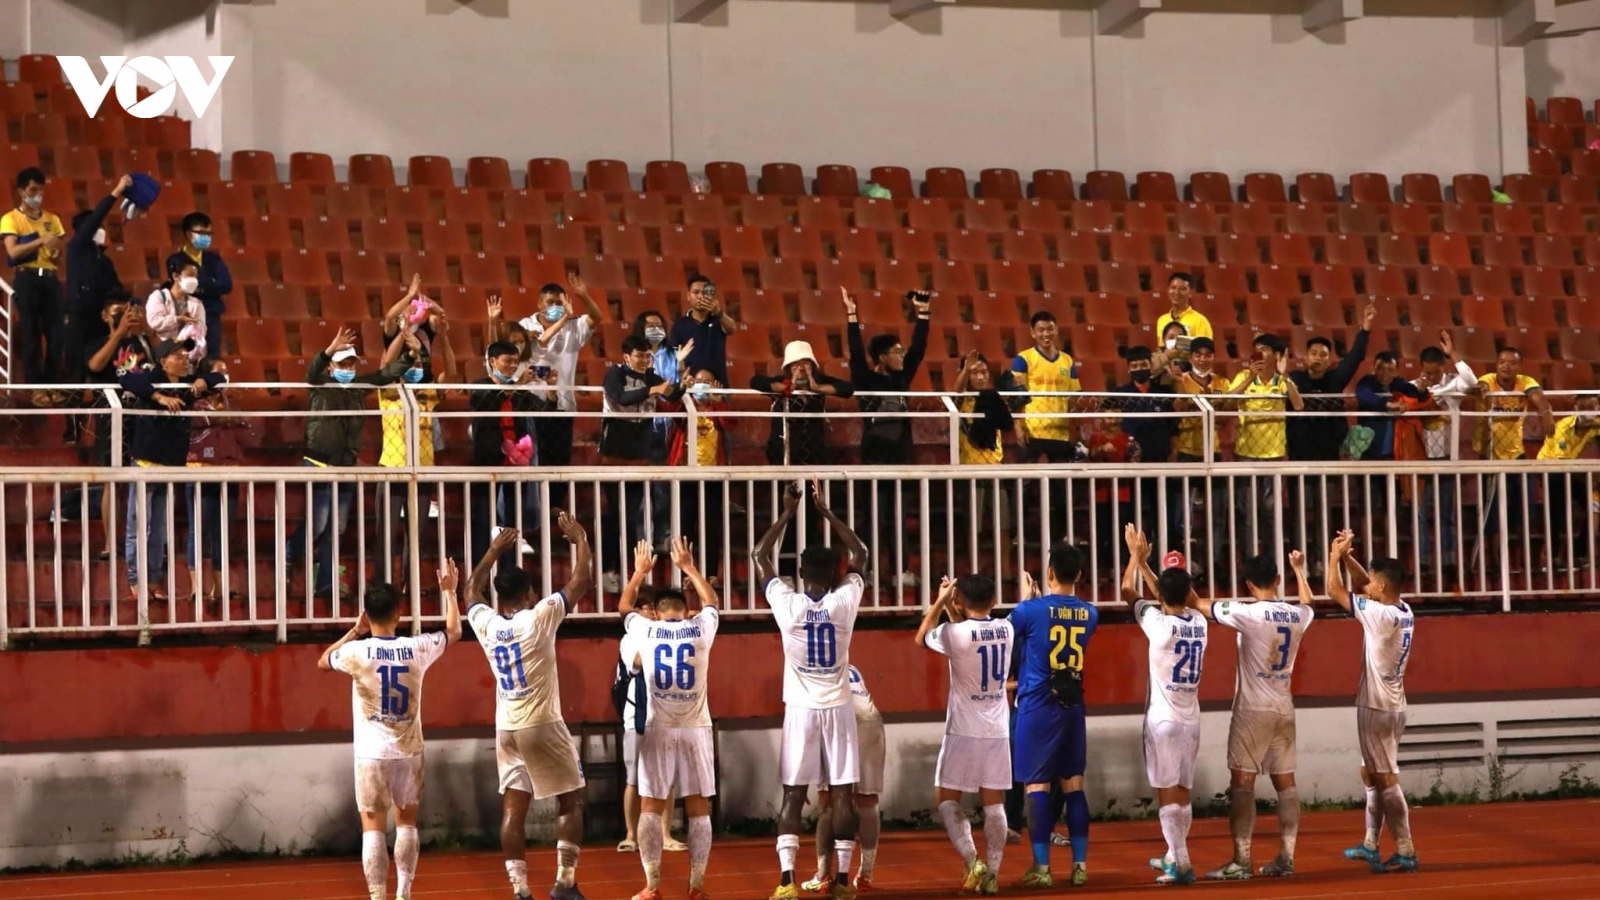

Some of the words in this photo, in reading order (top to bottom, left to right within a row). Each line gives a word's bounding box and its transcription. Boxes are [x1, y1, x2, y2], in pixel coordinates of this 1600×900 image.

[1049, 606, 1057, 619] T.
[367, 647, 375, 660] T.
[495, 642, 527, 690] 91
[654, 643, 695, 690] 66
[803, 622, 836, 667] 10
[1049, 625, 1086, 671] 25
[1172, 640, 1203, 684] 20
[1271, 626, 1291, 671] 3
[376, 665, 409, 715] 15
[977, 643, 1006, 692] 14
